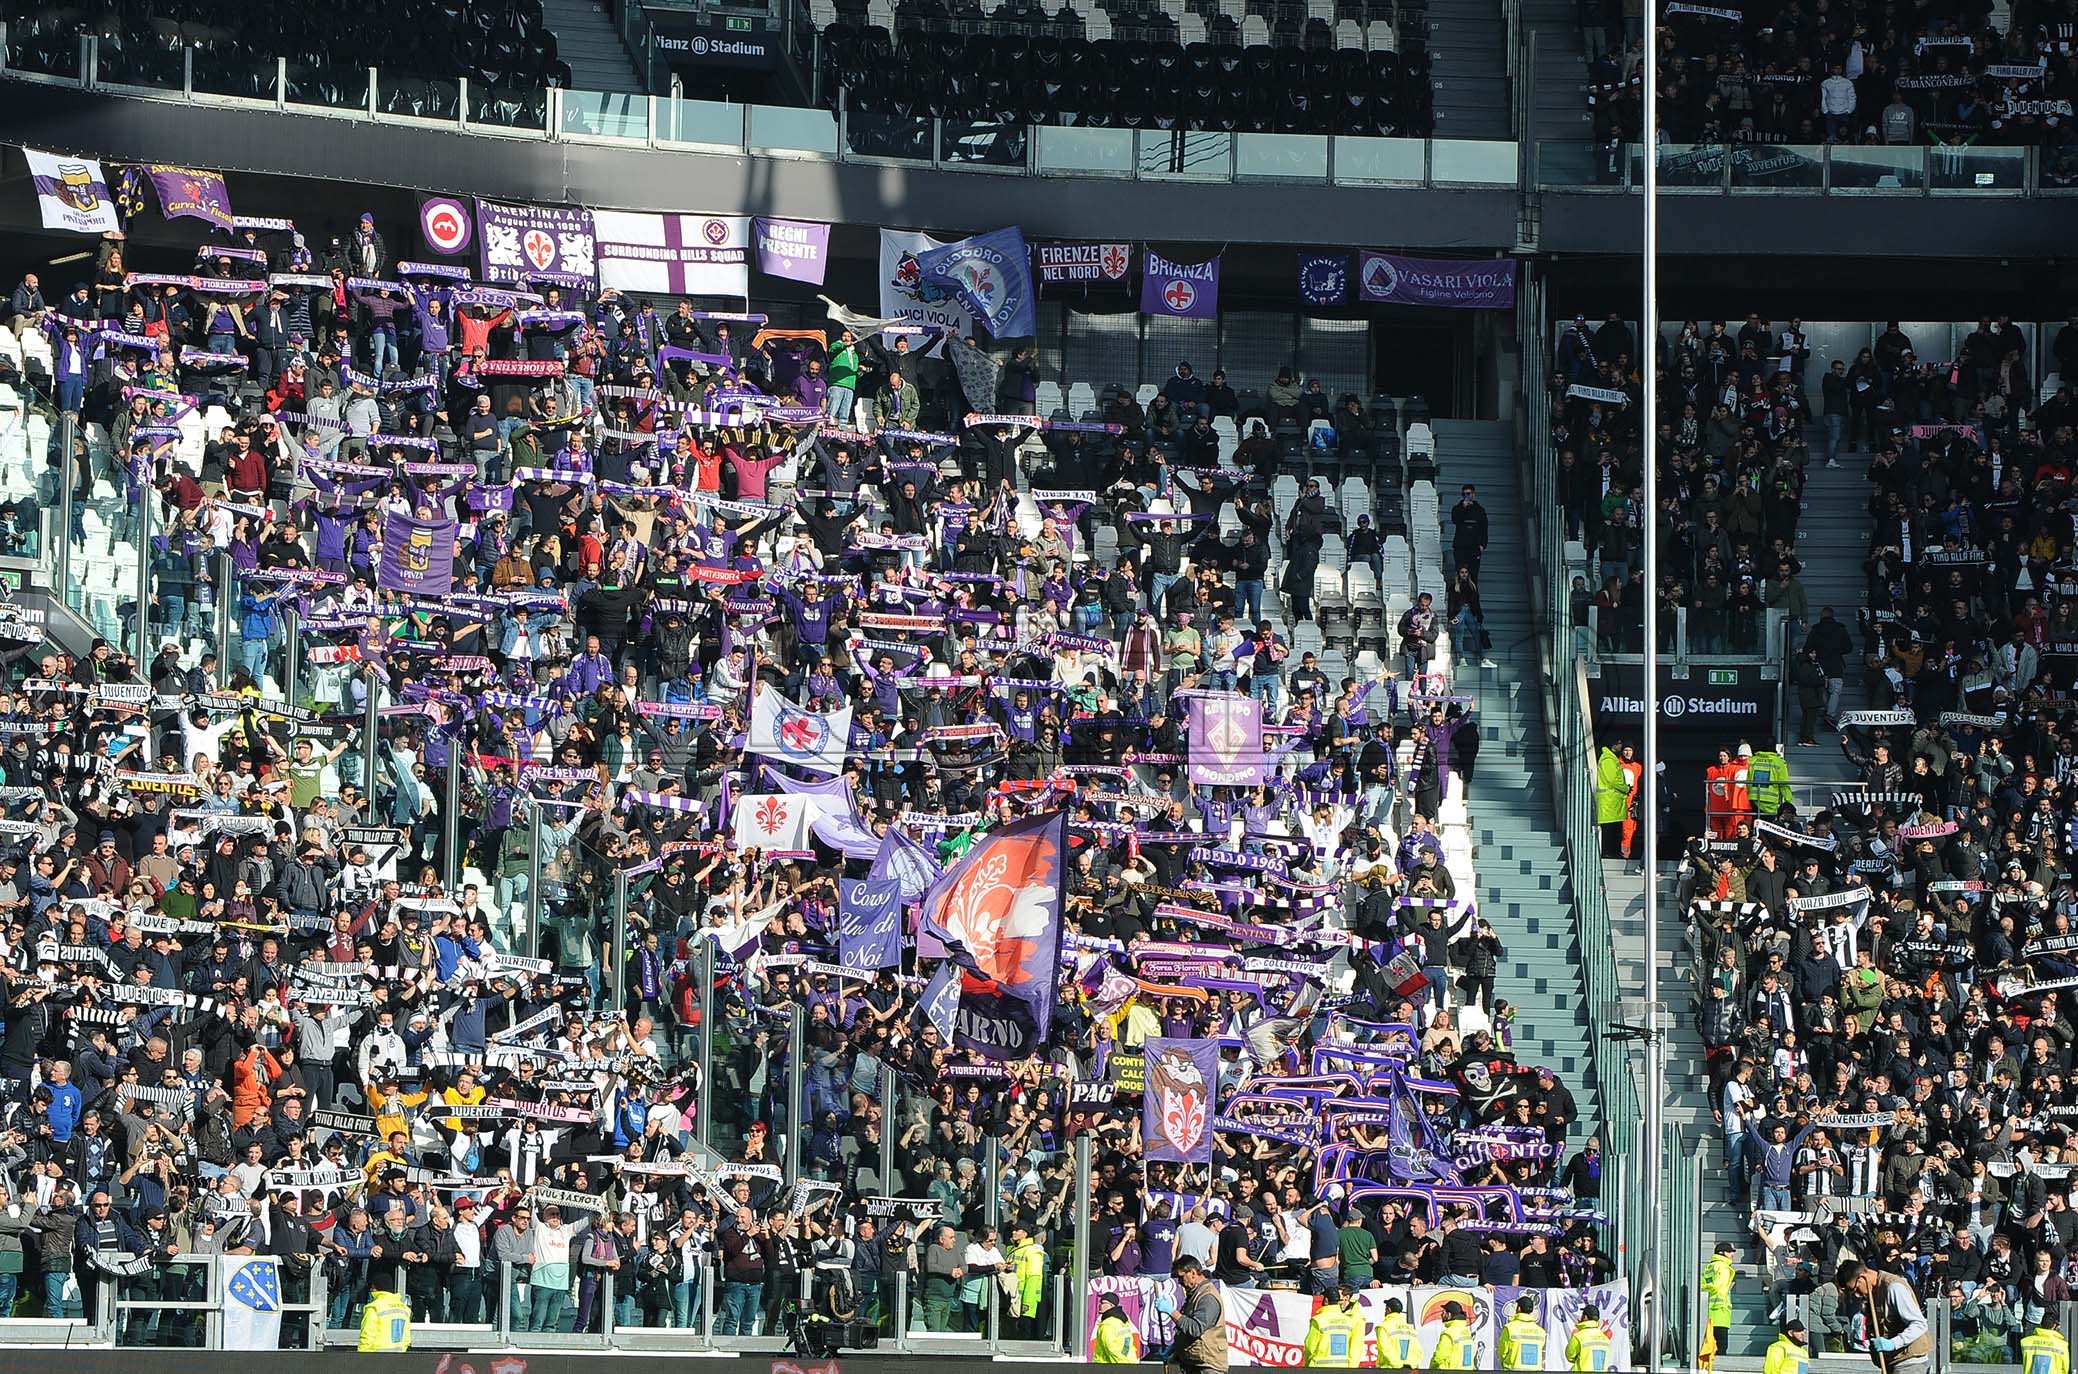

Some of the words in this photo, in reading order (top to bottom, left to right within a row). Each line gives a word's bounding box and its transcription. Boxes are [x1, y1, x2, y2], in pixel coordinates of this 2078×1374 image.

[711, 38, 765, 56] Stadium
[2008, 100, 2058, 115] JUVENTUS
[167, 201, 197, 212] Curva
[480, 200, 562, 221] FIORENTINA
[232, 215, 288, 229] ICIONADOS
[494, 214, 528, 228] August
[769, 224, 808, 244] REGNI
[603, 244, 678, 262] SURROUNDING
[680, 248, 708, 263] HILLS
[710, 249, 745, 263] SQUAD
[759, 236, 818, 261] PRESENTE
[1041, 245, 1099, 264] FIRENZE
[411, 262, 437, 272] VASARI
[438, 266, 463, 275] VIOLA
[1043, 267, 1065, 281] NEL
[1068, 264, 1100, 281] NORD
[1148, 255, 1214, 283] BRIANZA
[202, 281, 250, 291] FIORENTINA
[357, 277, 384, 288] VASARI
[1398, 269, 1461, 289] VASARI
[1463, 271, 1514, 288] VIOLA
[926, 310, 961, 329] VIOLA
[100, 329, 157, 348] AFICIONADOS
[488, 360, 547, 375] FIORENTINA
[772, 407, 813, 416] FIORENTINA
[822, 427, 872, 443] FIORENTINA
[219, 499, 259, 514] FIORENTINA
[482, 490, 502, 508] 13
[680, 490, 717, 508] JUVE
[718, 500, 767, 517] MERDA
[1933, 552, 1949, 563] FINO
[1950, 551, 1968, 562] ALLA
[1969, 551, 1985, 562] FINE
[416, 601, 443, 613] GRUPPO
[443, 604, 483, 619] PINTASPORT
[0, 622, 31, 638] ENTUS
[863, 639, 920, 656] FIORENTINA
[1052, 631, 1103, 651] IORENTINA
[103, 685, 148, 699] JUVENTUS
[258, 700, 275, 713] FINO
[275, 703, 292, 716] ALLA
[292, 706, 310, 720] FINE
[657, 703, 706, 717] FIORENTINA
[1600, 696, 1661, 714] Alliaz
[1687, 697, 1758, 715] Stadium
[1853, 711, 1907, 723] JUVENTUS
[299, 725, 334, 736] JUVENTUS
[943, 725, 995, 738] FIORENTINA
[554, 767, 571, 779] NEL
[126, 779, 197, 799] JUVENTUS
[348, 830, 363, 842] FINO
[364, 831, 379, 843] ALLA
[380, 831, 396, 844] FINE
[1903, 822, 1946, 837] JUVENTUS
[1709, 841, 1739, 852] JUVENTUS
[1250, 854, 1285, 872] 1965
[1853, 857, 1886, 869] DERFUL
[135, 913, 168, 929] JUVE
[180, 919, 214, 934] JUVE
[874, 911, 897, 934] di
[1231, 923, 1273, 940] ENTINA
[1907, 941, 1941, 951] SOLO
[1943, 942, 1976, 960] JUVE
[2046, 937, 2066, 949] FINO
[2067, 936, 2078, 946] AL
[495, 954, 544, 973] JUVENTUS
[844, 943, 884, 969] Noi
[814, 961, 866, 979] FIORENTINA
[1263, 958, 1316, 972] COLLETTIVO
[294, 967, 336, 988] JUVENTUS
[112, 984, 169, 1004] JUVENTUS
[304, 987, 359, 1002] JUVENTUS
[1112, 1056, 1144, 1067] CONTR
[949, 1064, 1003, 1077] FIORENTINA
[1121, 1068, 1144, 1080] CALC
[1115, 1080, 1144, 1091] MODE
[450, 1107, 504, 1118] JUVENTUS
[514, 1100, 567, 1119] JUVENTUS
[315, 1111, 333, 1126] FINO
[334, 1114, 353, 1129] ALLA
[354, 1117, 373, 1132] FINE
[1821, 1113, 1876, 1126] JUVENTUS
[725, 1163, 771, 1176] JUVENTUS
[1996, 1163, 2014, 1175] FINO
[126, 1256, 153, 1275] WHITE
[1245, 1293, 1281, 1339] A
